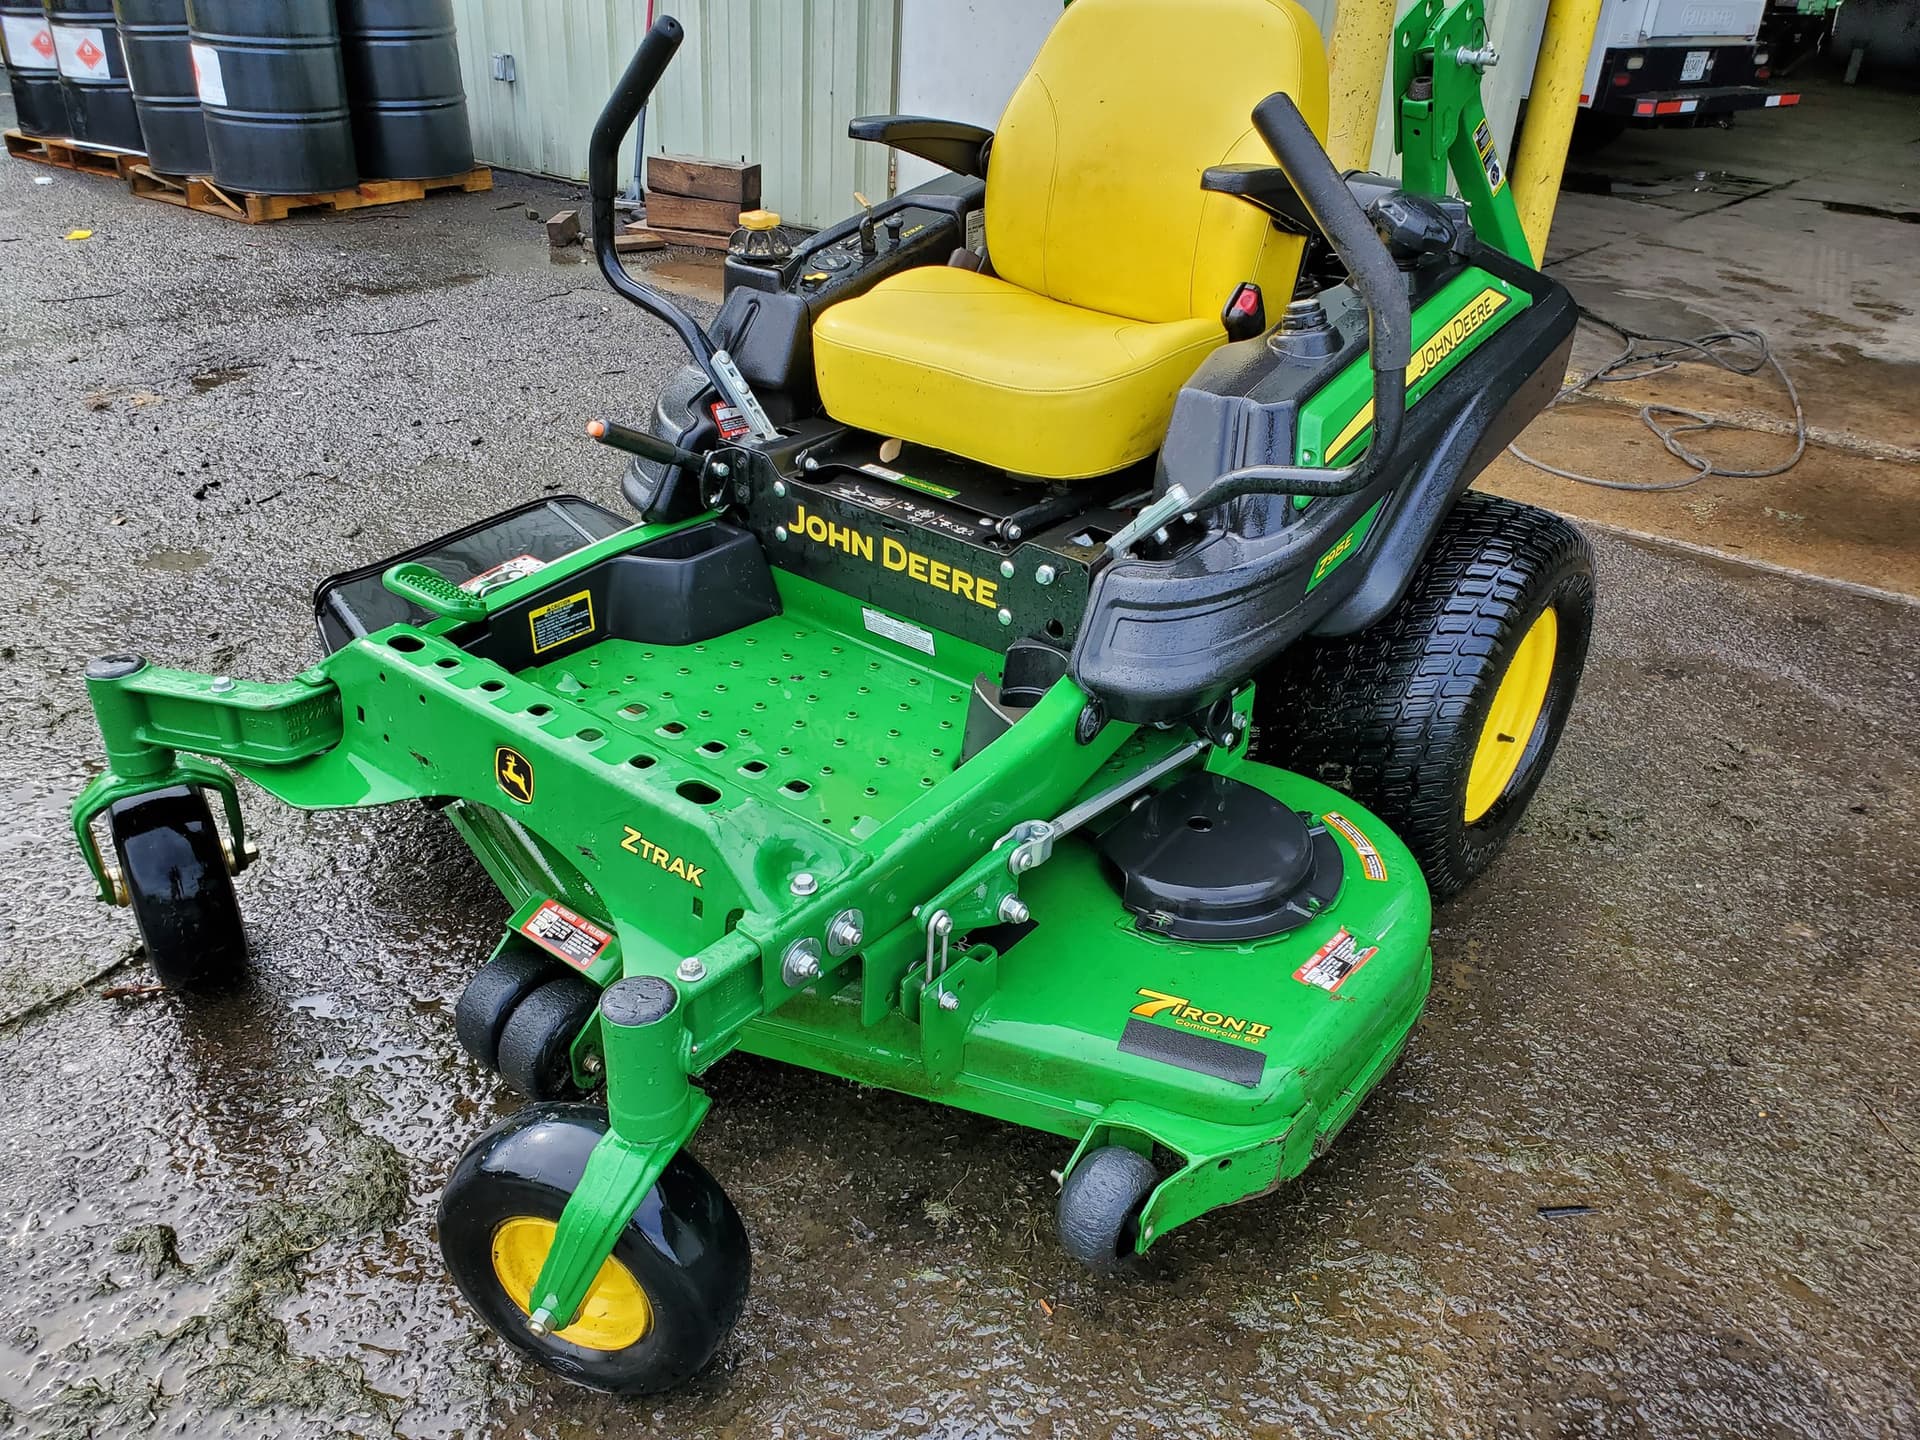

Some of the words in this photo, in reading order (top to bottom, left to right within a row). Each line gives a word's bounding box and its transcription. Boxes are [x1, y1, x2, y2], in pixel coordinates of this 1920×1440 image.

[1420, 331, 1453, 374] JOHN
[1453, 296, 1493, 342] DEERE
[788, 504, 873, 562] JOHN
[883, 536, 999, 609] DEERE
[620, 825, 706, 889] ZTRAK
[1175, 1018, 1242, 1040] Commercial
